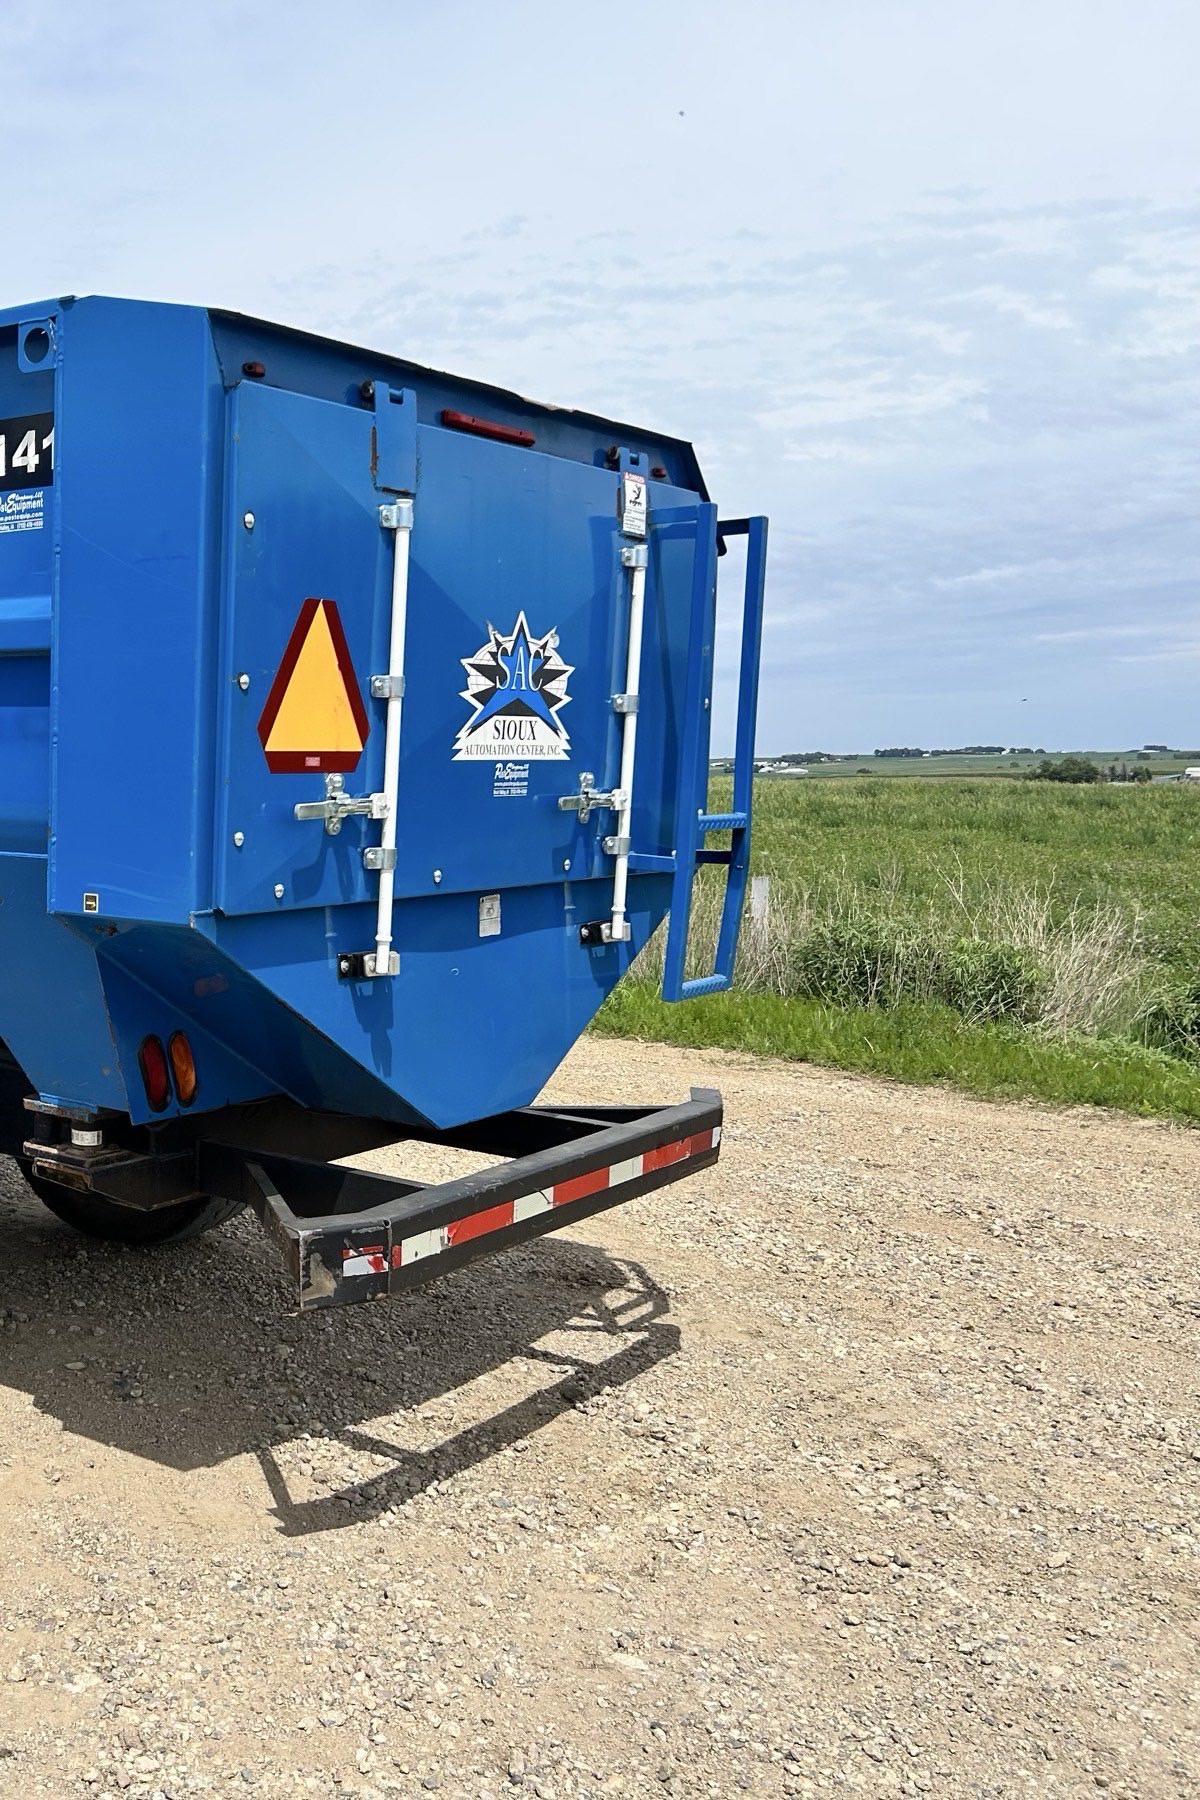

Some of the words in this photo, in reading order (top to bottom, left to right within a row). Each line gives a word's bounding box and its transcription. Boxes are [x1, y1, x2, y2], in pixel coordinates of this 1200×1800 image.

[496, 646, 544, 691] SAC
[492, 719, 538, 741] SIOUX
[464, 744, 515, 756] AUTOMATION
[516, 744, 546, 757] CENTER,
[547, 745, 561, 756] INC.
